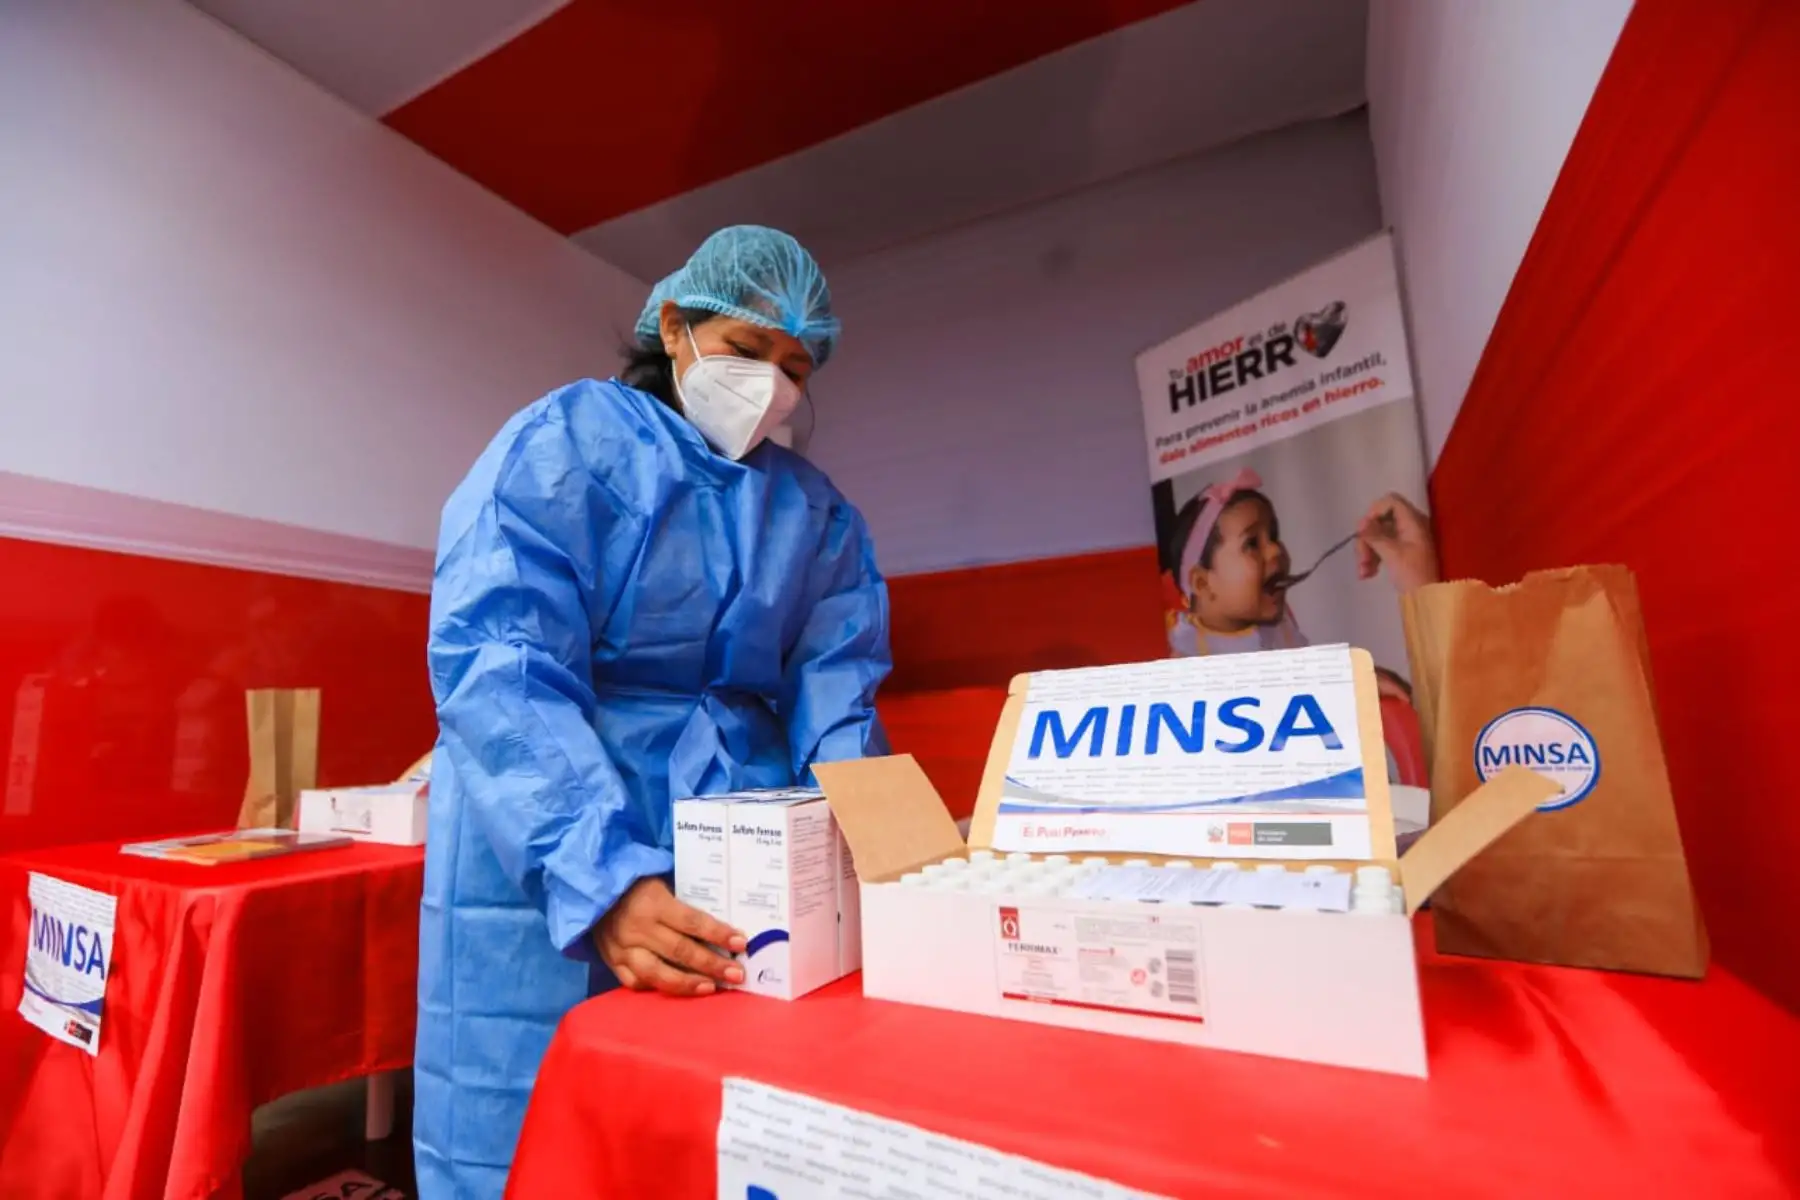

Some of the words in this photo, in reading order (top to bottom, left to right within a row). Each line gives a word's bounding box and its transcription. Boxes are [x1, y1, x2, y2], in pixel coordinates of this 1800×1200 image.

[1168, 368, 1184, 381] Tu
[1186, 335, 1245, 374] amor
[1247, 331, 1264, 347] es
[1267, 320, 1288, 340] de
[1155, 430, 1183, 449] Para
[1184, 409, 1242, 442] prevenir
[1245, 402, 1258, 417] la
[1261, 379, 1317, 411] anemia
[1320, 351, 1388, 387] infantil,
[1159, 446, 1187, 465] dale
[1189, 421, 1259, 454] alimentos
[1260, 405, 1300, 429] ricos
[1301, 397, 1322, 413] en
[1324, 375, 1386, 405] hierro.
[1027, 693, 1345, 760] MINSA
[1482, 742, 1590, 767] MINSA
[33, 907, 105, 981] MINSA
